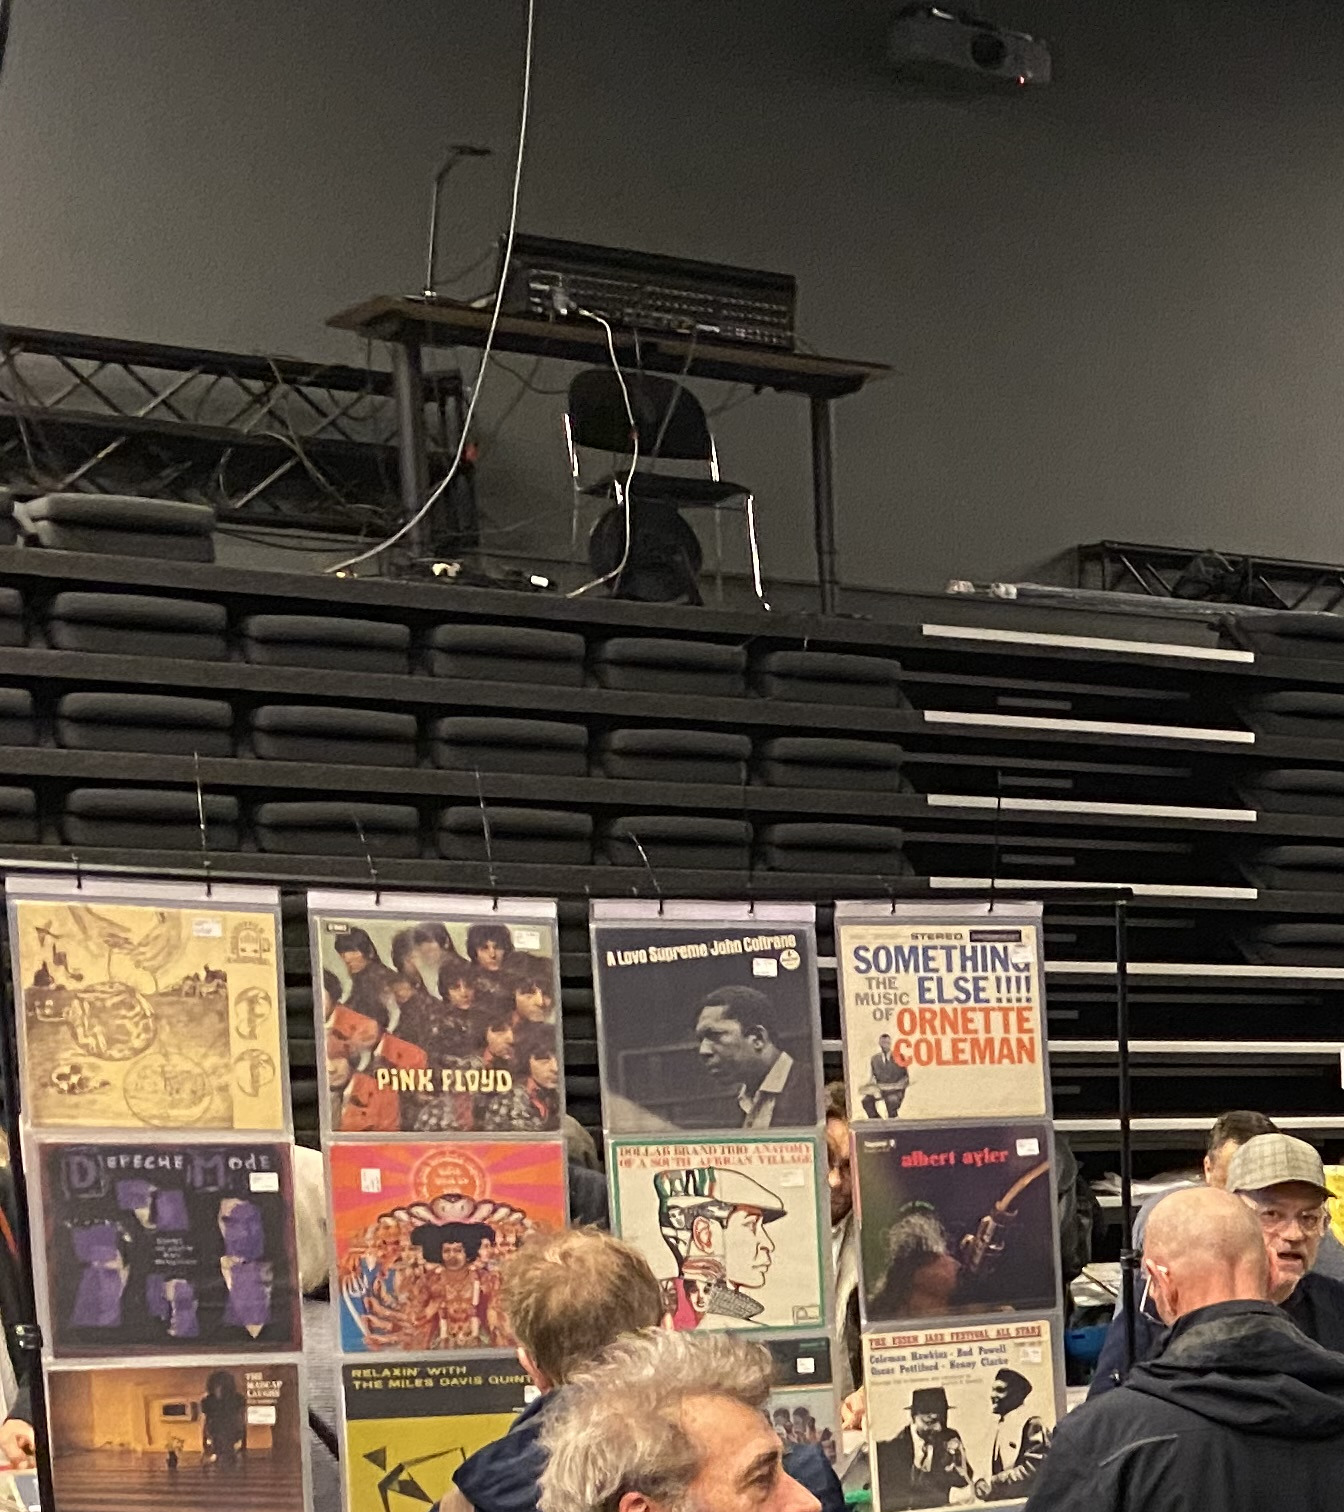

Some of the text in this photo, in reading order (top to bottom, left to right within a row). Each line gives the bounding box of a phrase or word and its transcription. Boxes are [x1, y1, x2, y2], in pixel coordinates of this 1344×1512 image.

[911, 932, 964, 941] STEREO
[606, 934, 797, 967] A Love Supreme John Coltrane
[865, 976, 899, 991] THE
[854, 992, 911, 1006] MUSIC
[872, 1007, 896, 1021] OF
[896, 1006, 1036, 1036] ORNETTE
[893, 1036, 1037, 1067] COLEMAN
[442, 1068, 513, 1092] FLOYD
[901, 1147, 1009, 1168] albert ayler
[426, 1365, 467, 1376] WITH
[352, 1379, 384, 1391] THE
[388, 1378, 434, 1390] MILES
[439, 1375, 483, 1388] DAVIS
